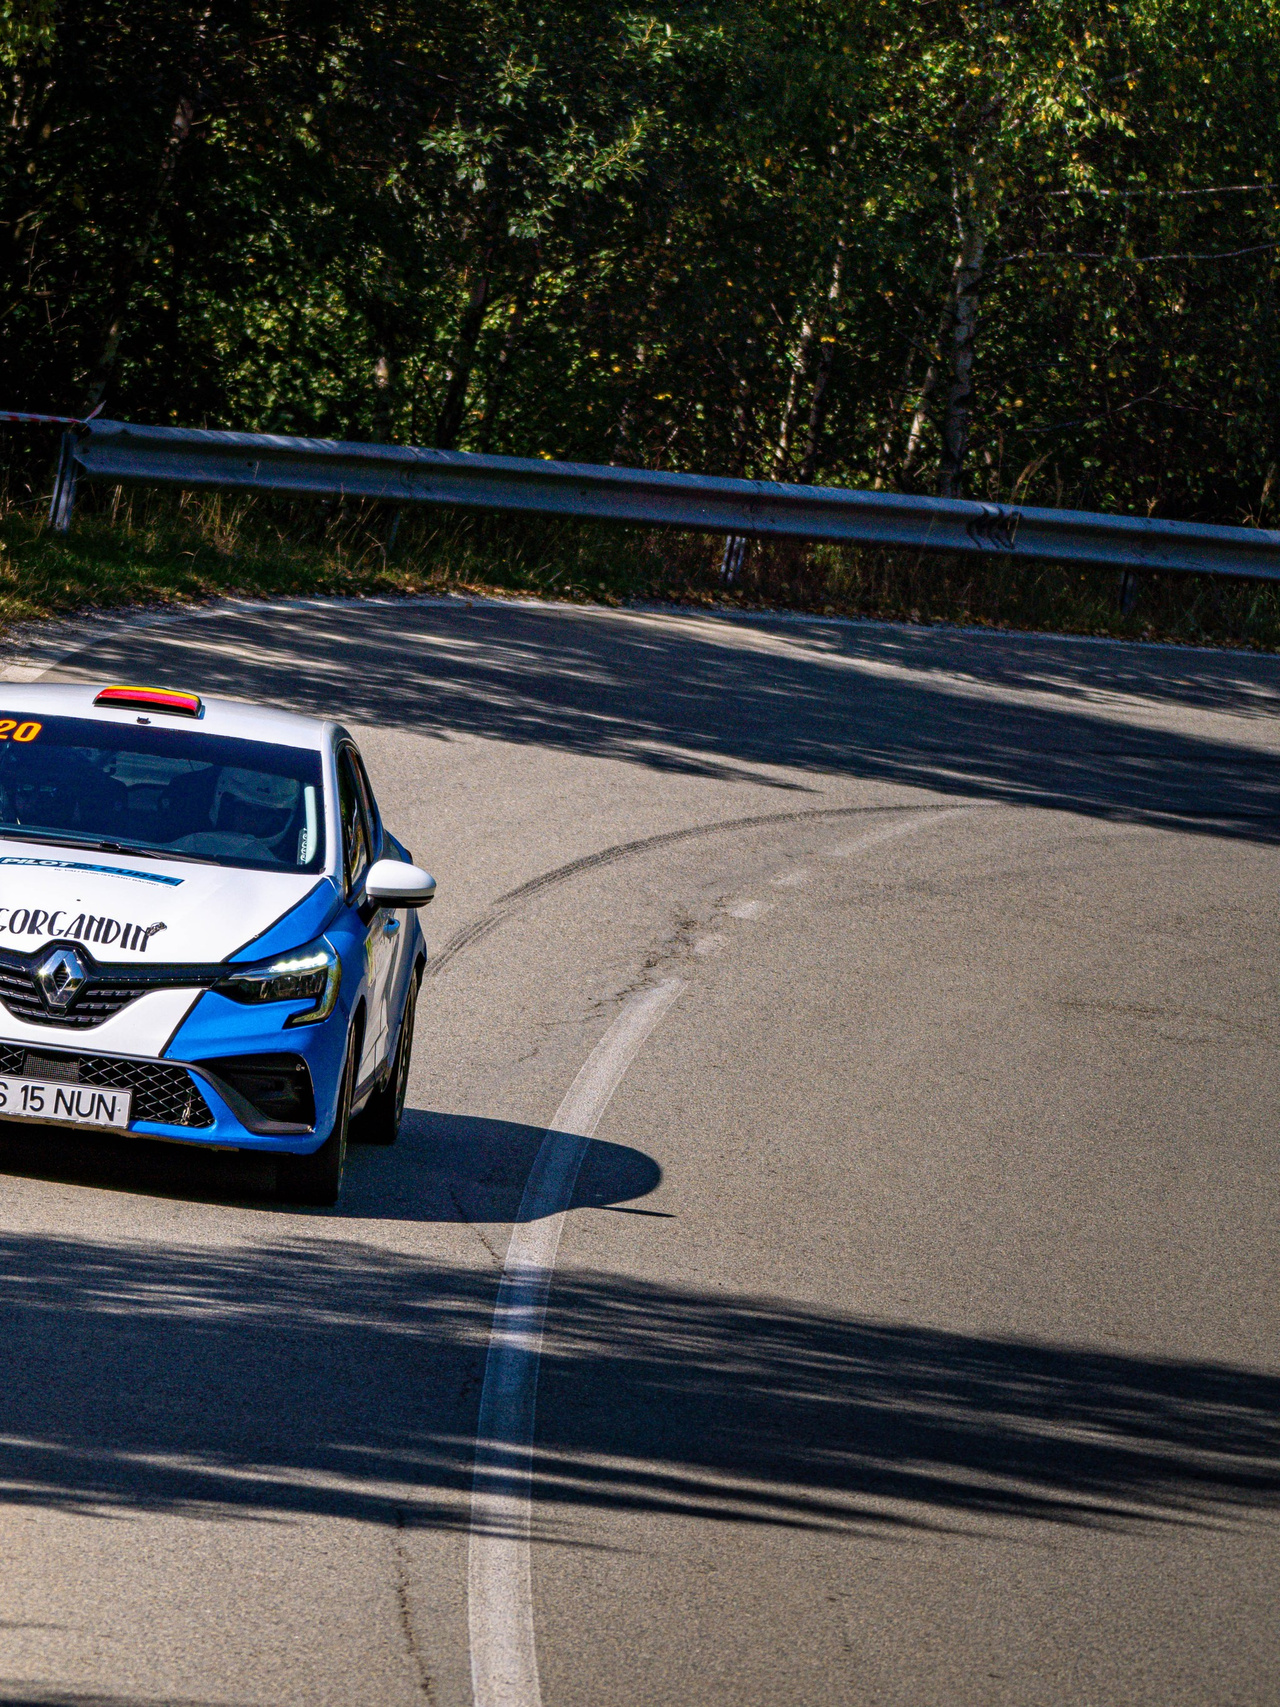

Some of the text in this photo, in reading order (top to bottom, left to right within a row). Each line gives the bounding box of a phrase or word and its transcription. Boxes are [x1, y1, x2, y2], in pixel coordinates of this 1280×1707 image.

[1, 858, 75, 867] PILOT
[20, 1085, 45, 1112] 15
[54, 1088, 117, 1122] NUN
